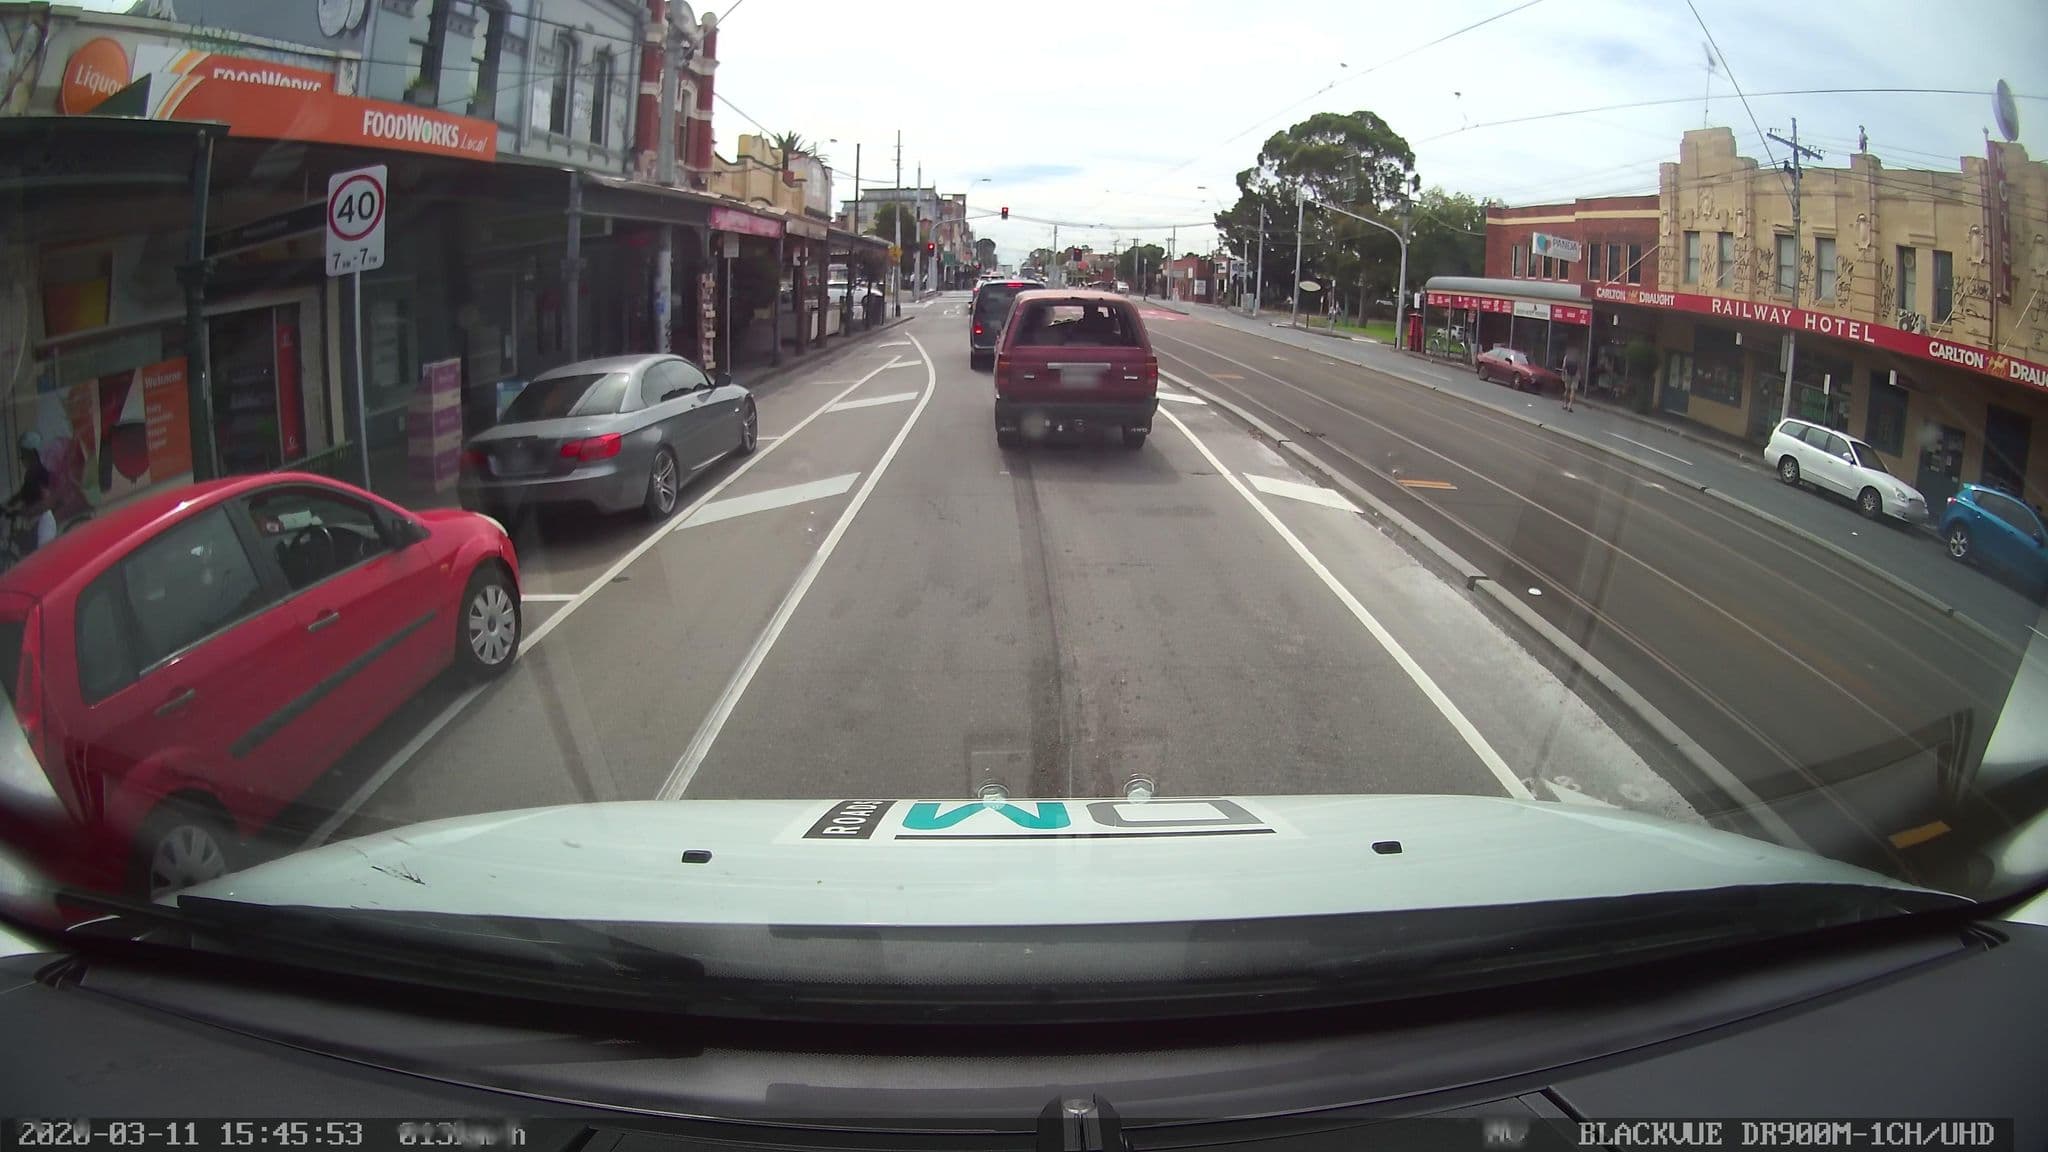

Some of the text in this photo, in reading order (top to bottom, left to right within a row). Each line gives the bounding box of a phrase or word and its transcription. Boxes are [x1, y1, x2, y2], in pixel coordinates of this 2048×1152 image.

[337, 191, 375, 223] 40
[1596, 287, 1675, 306] CARLTON DRAUGHT
[1711, 299, 1792, 324] RAILWAY
[1804, 314, 1876, 343] HOTEL
[1929, 341, 1984, 369] CARLTON
